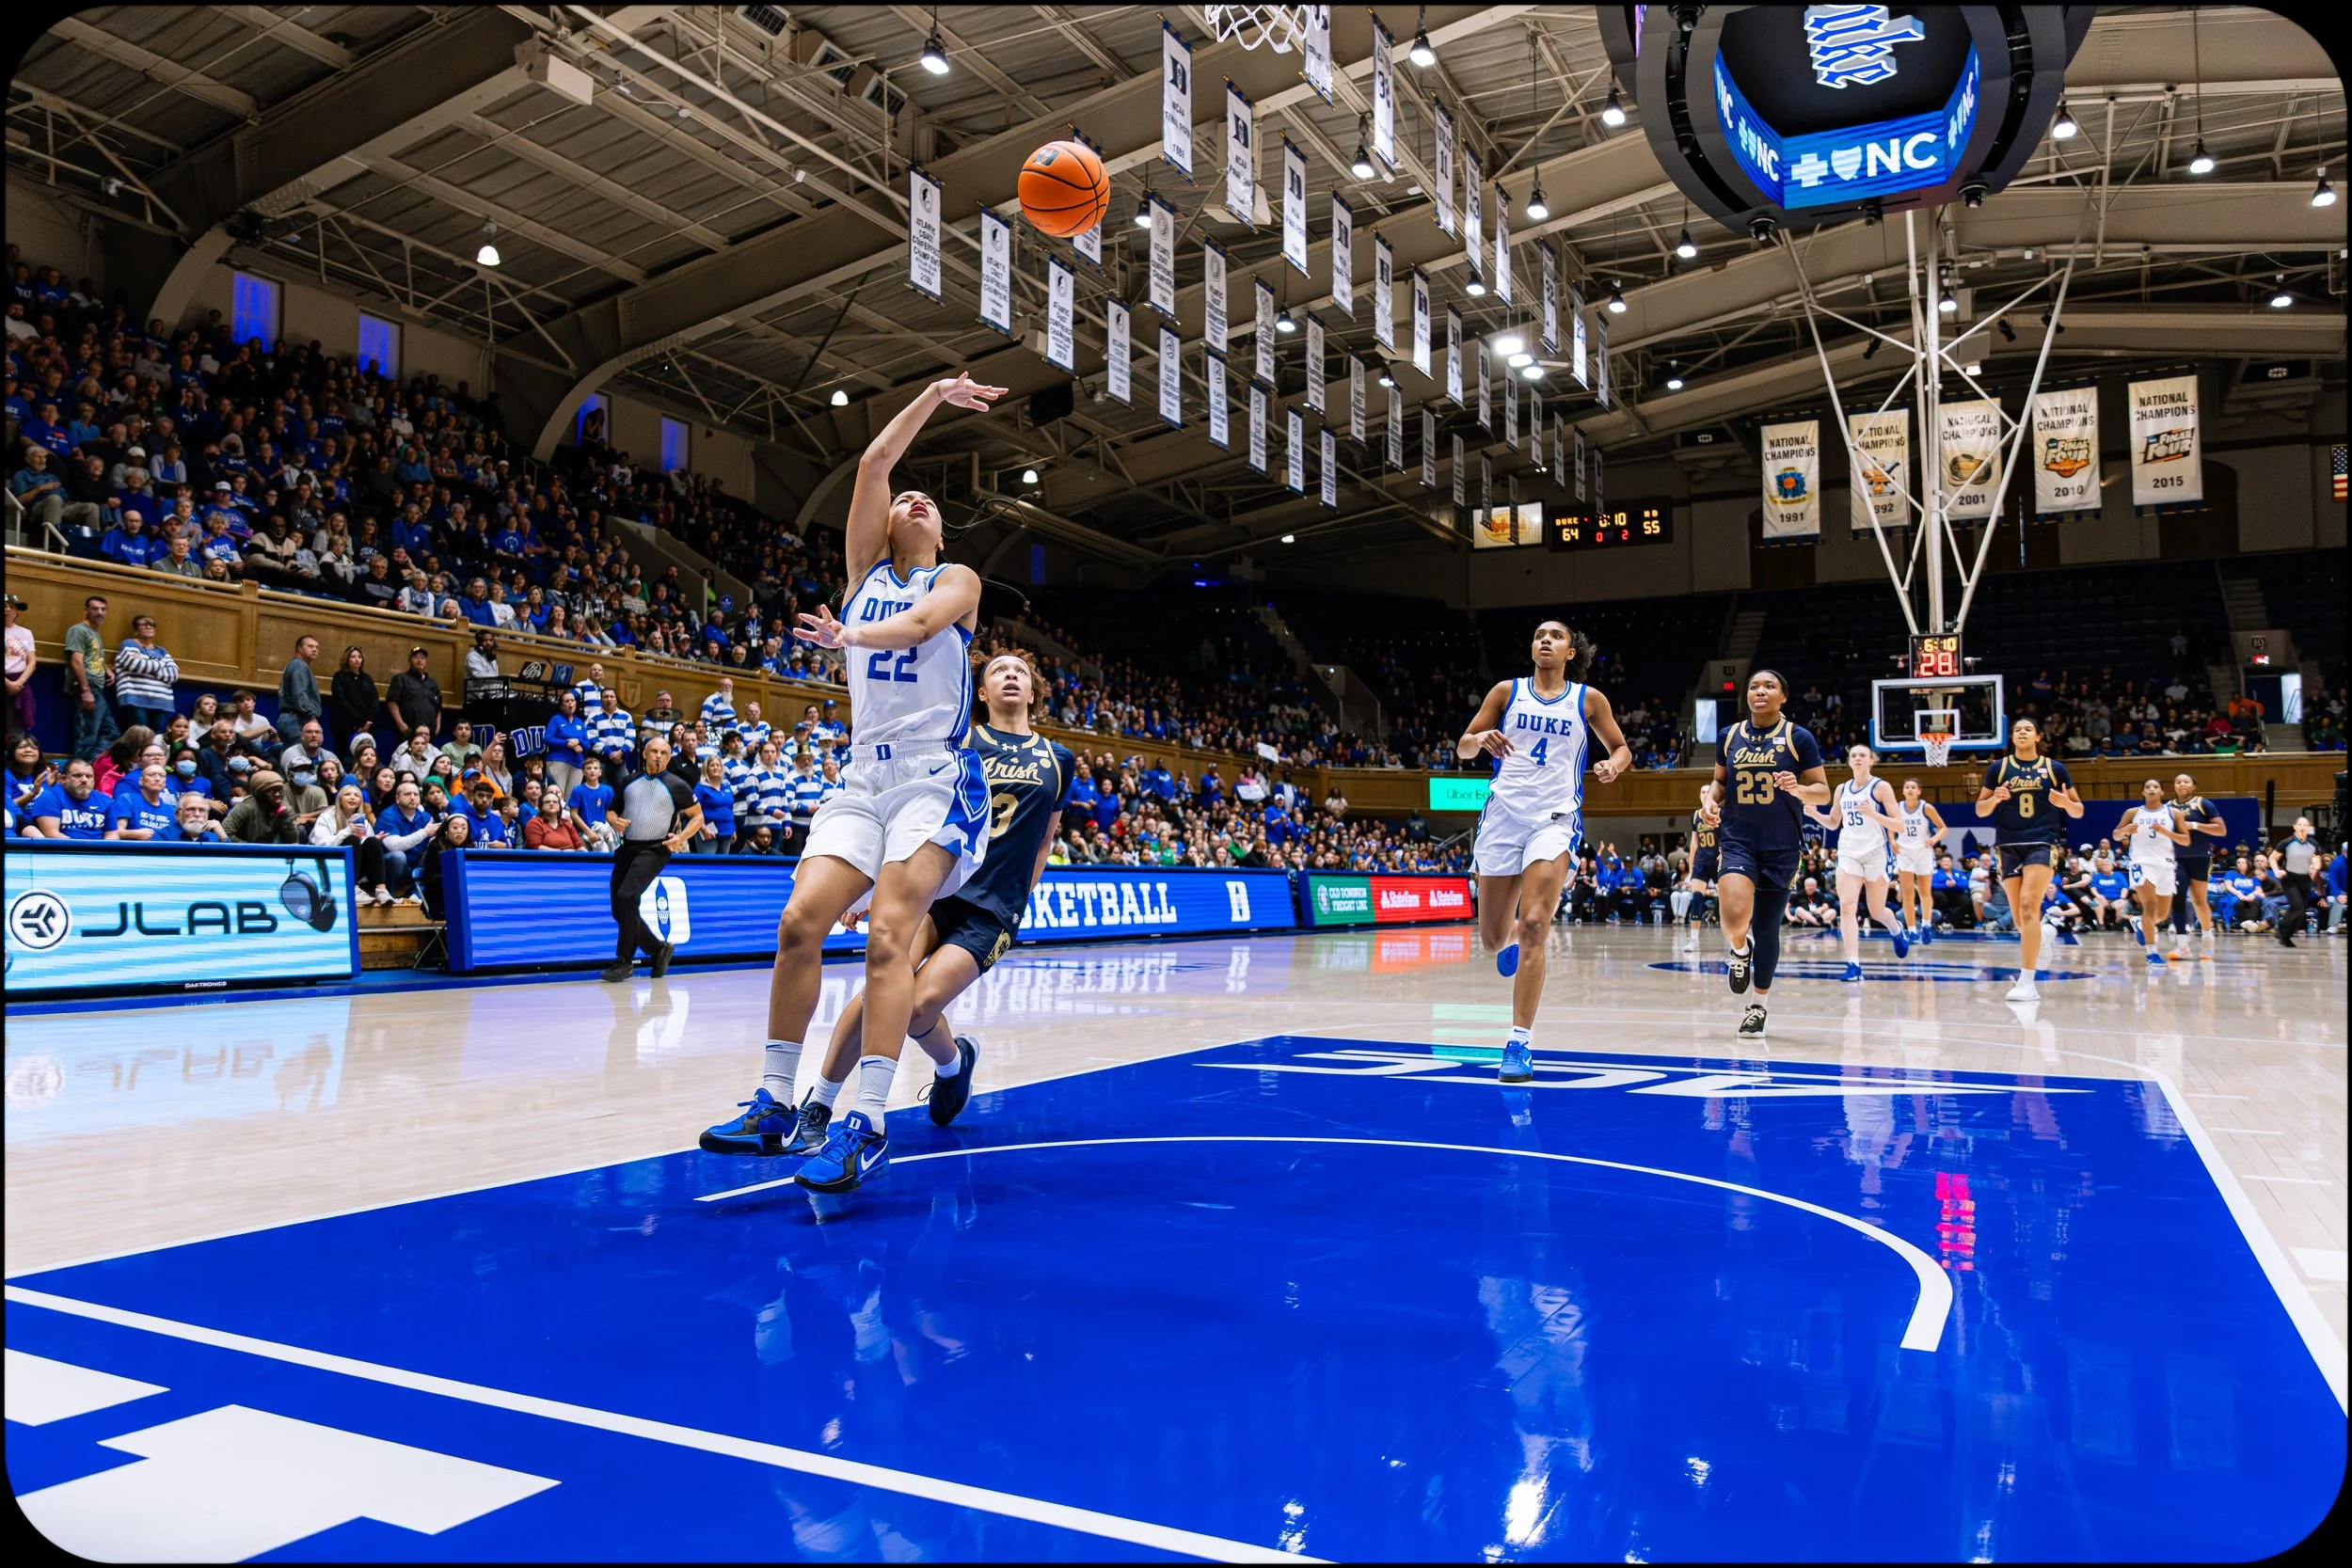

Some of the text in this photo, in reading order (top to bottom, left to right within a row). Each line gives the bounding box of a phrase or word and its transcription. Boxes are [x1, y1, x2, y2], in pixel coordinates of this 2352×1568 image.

[1804, 5, 1925, 88] uke
[1756, 135, 1779, 182] NC
[1867, 132, 1938, 177] NC
[2138, 391, 2188, 407] NATIONAL
[2134, 404, 2195, 421] CHAMPIONS
[1857, 425, 1900, 437] NTIONAL
[2037, 415, 2094, 432] CHAMPIONS
[1857, 436, 1905, 451] HAMPIONS
[2147, 439, 2192, 461] FOUR
[1764, 447, 1816, 461] CHAMPIONS
[2153, 476, 2184, 488] 2015
[2055, 484, 2084, 497] 2010
[1959, 494, 1986, 506] 2001
[1779, 511, 1804, 523] 1991
[1873, 503, 1894, 515] 992
[1555, 516, 1580, 527] DUKE
[1562, 528, 1580, 542] 64
[1924, 637, 1958, 653] 6:10
[866, 646, 918, 684] 22
[1920, 652, 1953, 676] 28
[1517, 713, 1572, 736] DUKE
[511, 725, 547, 758] DU
[1530, 737, 1549, 767] 4
[1733, 747, 1777, 768] Irish
[1736, 771, 1774, 805] 23
[2009, 775, 2043, 792] Irish
[1446, 789, 1472, 800] Uber
[2019, 793, 2034, 818] 8
[1847, 811, 1864, 827] 35
[1906, 826, 1918, 837] 12
[1698, 832, 1716, 848] 30
[1328, 887, 1340, 898] OLD
[81, 901, 278, 938] JLAB
[184, 980, 228, 989] DAKTRONICS
